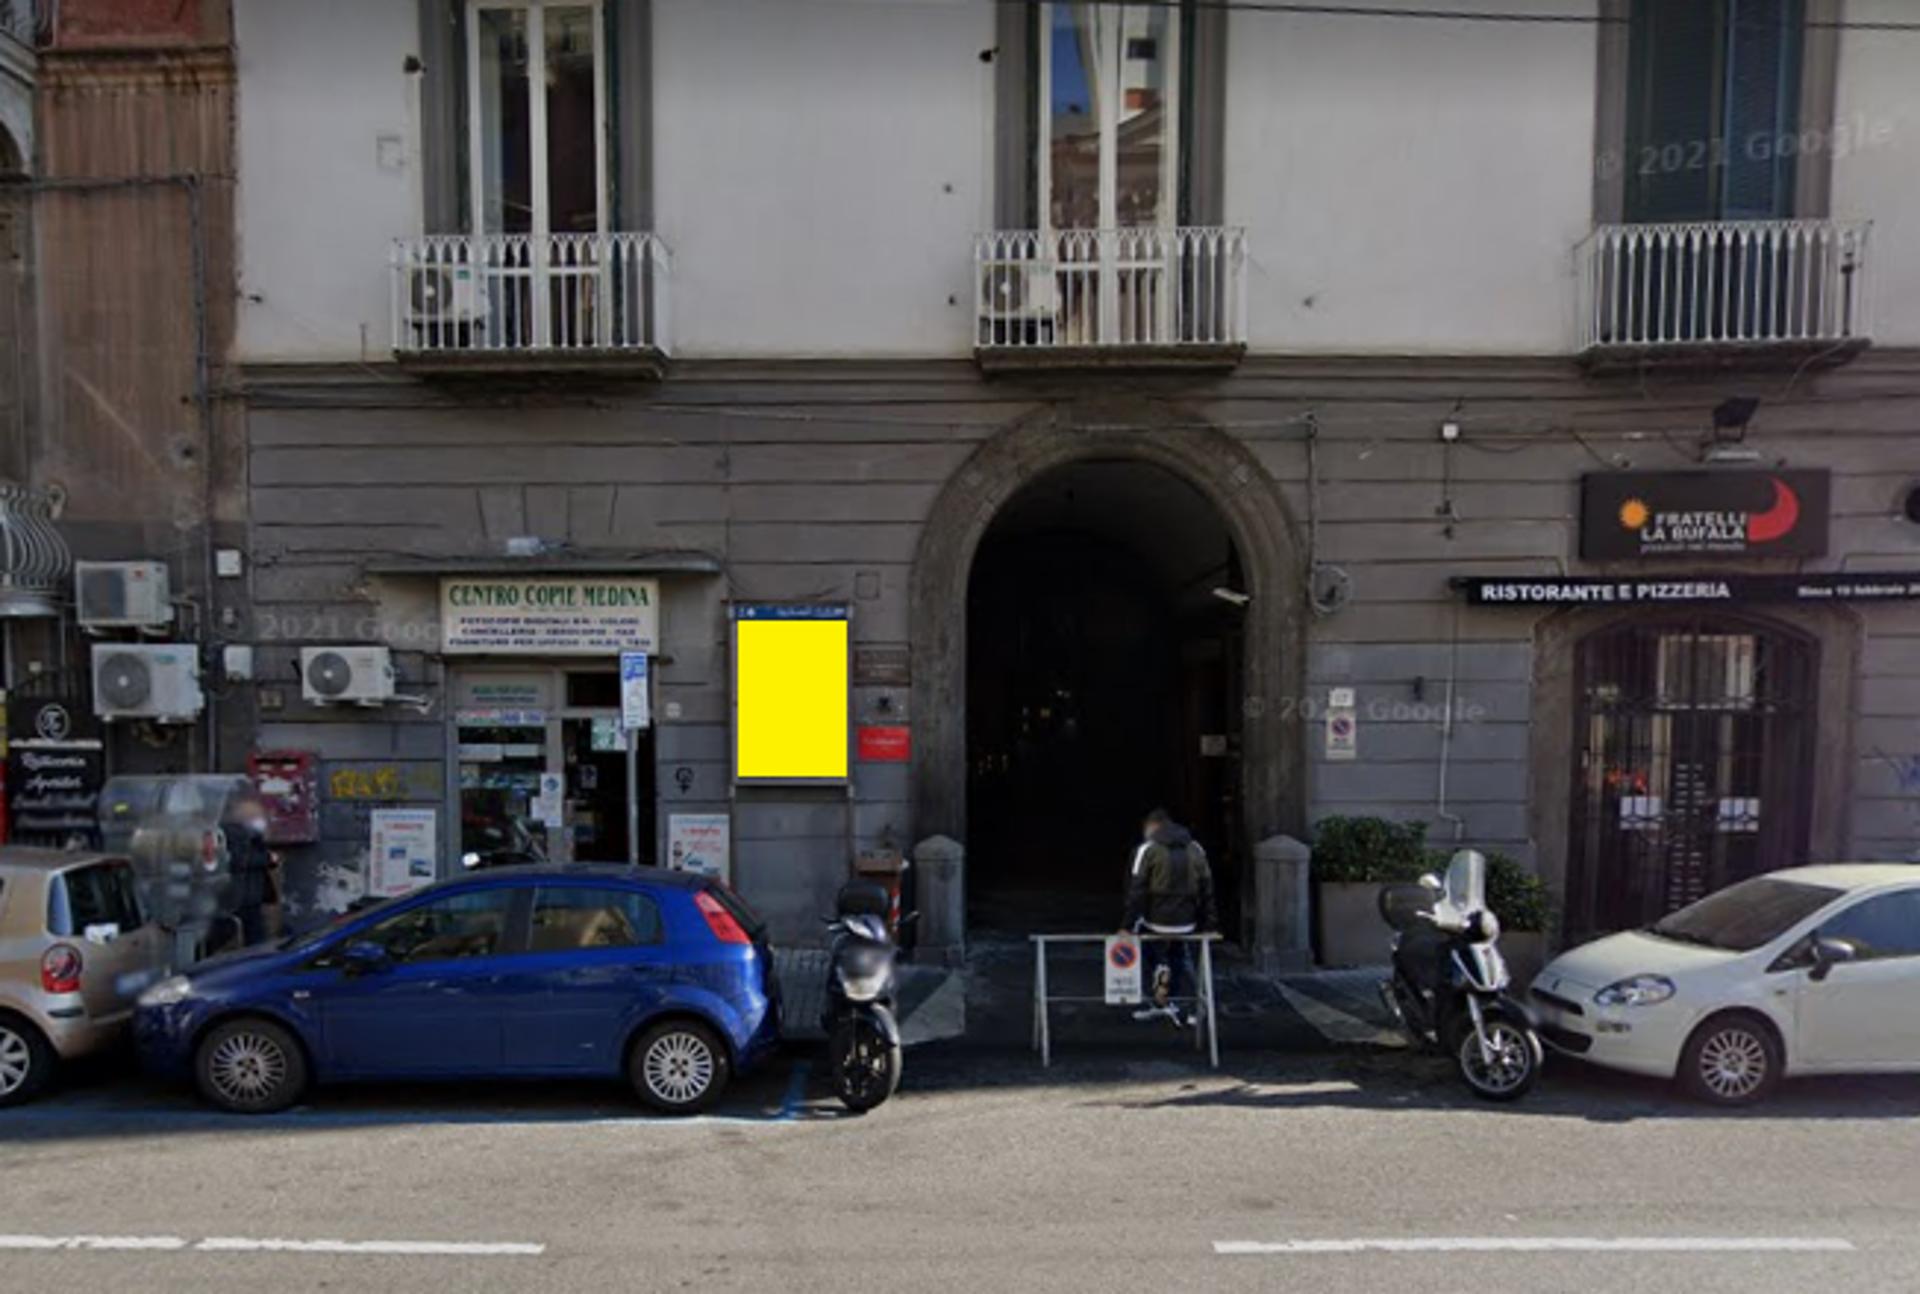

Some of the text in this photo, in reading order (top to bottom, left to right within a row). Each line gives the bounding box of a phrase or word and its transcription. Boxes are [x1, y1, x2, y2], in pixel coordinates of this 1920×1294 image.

[1655, 511, 1746, 527] FRATELLI
[1641, 525, 1746, 541] LA BUFALA
[449, 584, 650, 606] CENTRO COPIE MEDINA
[1481, 582, 1731, 602] RISTORANTE E PIZZERIA
